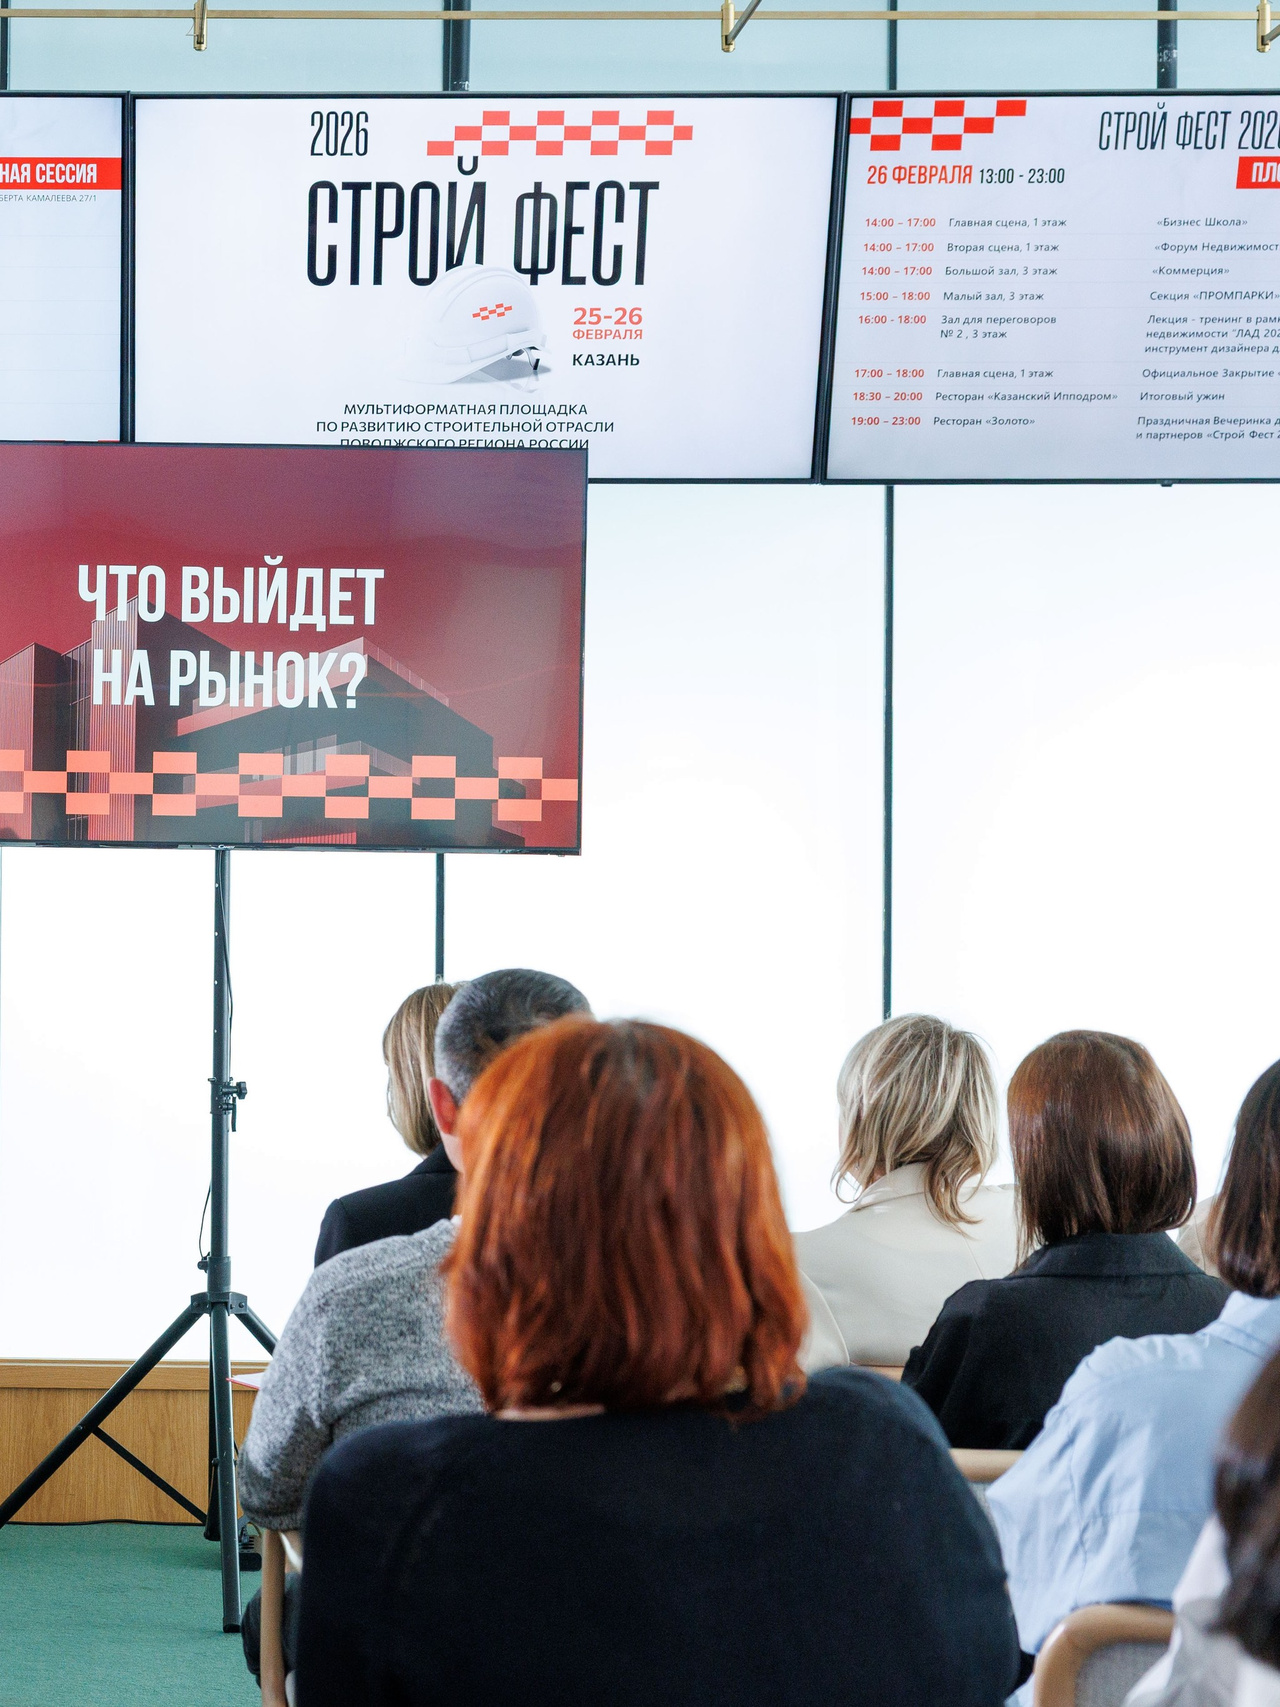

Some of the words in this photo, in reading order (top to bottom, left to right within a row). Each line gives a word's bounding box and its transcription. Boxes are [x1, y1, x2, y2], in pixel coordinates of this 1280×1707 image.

[1099, 102, 1167, 150] СТРОЙ
[1176, 111, 1231, 150] ФЕСТ
[311, 111, 368, 156] 2026
[36, 164, 96, 183] СЕССИЯ
[867, 165, 887, 184] 26
[892, 165, 972, 184] ФЕВРАЛЯ
[979, 168, 1015, 184] 13:00
[1027, 167, 1065, 184] 23:00
[25, 193, 78, 203] КАМАЛЕЕВА
[78, 193, 98, 203] 27/1
[307, 156, 486, 286] СТРОЙ
[514, 180, 659, 286] ФЕСТ
[948, 217, 993, 228] Главная
[995, 219, 1030, 229] сцена,
[1041, 219, 1067, 227] этаж
[1156, 217, 1201, 227] «Бизнес
[1204, 217, 1248, 227] Школа»
[947, 242, 985, 255] Вторая
[987, 244, 1022, 254] сцена,
[1034, 244, 1060, 252] этаж
[1154, 242, 1198, 254] «Форум
[945, 265, 995, 276] Большой
[998, 268, 1019, 276] зал,
[1032, 268, 1058, 276] этаж
[1152, 265, 1230, 278] «Коммерция»
[943, 290, 983, 301] Малый
[984, 293, 1006, 302] зал,
[1018, 293, 1045, 301] этаж
[1149, 291, 1190, 302] Секция
[1193, 290, 1280, 301] «ПРОМПАРКИ»
[574, 307, 642, 325] 25-26
[941, 314, 961, 325] Зал
[962, 317, 983, 326] для
[985, 316, 1057, 327] переговоров
[1146, 314, 1188, 326] Лекция
[1199, 316, 1243, 326] тренинг
[572, 328, 643, 340] ФЕВРАЛЯ
[981, 331, 1008, 339] этаж
[1146, 330, 1229, 340] недвижимости
[1144, 345, 1208, 356] инструмент
[1210, 343, 1270, 355] дизайнера
[572, 353, 640, 367] КАЗАНЬ
[1142, 368, 1219, 380] Официальное
[1222, 368, 1275, 380] Закрытие
[935, 391, 985, 404] Ресторан
[987, 391, 1051, 401] «Казанский
[1053, 391, 1118, 403] Ипподром»
[1139, 391, 1194, 401] Итоговый
[1196, 393, 1225, 404] ужин
[343, 403, 496, 415] МУЛЬТИФОРМАТНАЯ
[499, 403, 588, 417] ПЛОЩАДКА
[316, 421, 338, 433] ПО
[340, 421, 421, 433] РАЗВИТИЮ
[424, 418, 543, 433] СТРОИТЕЛЬНОЙ
[545, 421, 614, 433] ОТРАСЛИ
[933, 416, 983, 428] Ресторан
[985, 416, 1036, 426] «Золото»
[1137, 416, 1211, 428] Праздничная
[1213, 415, 1272, 428] Вечеринка
[1145, 432, 1203, 442] партнеров
[1206, 429, 1245, 442] «Строй
[1248, 430, 1274, 440] Фест
[78, 564, 165, 623] ЧТО
[182, 556, 384, 631] ВЫЙДЕТ
[93, 648, 154, 706] НА
[170, 650, 367, 709] РЫНОК?
